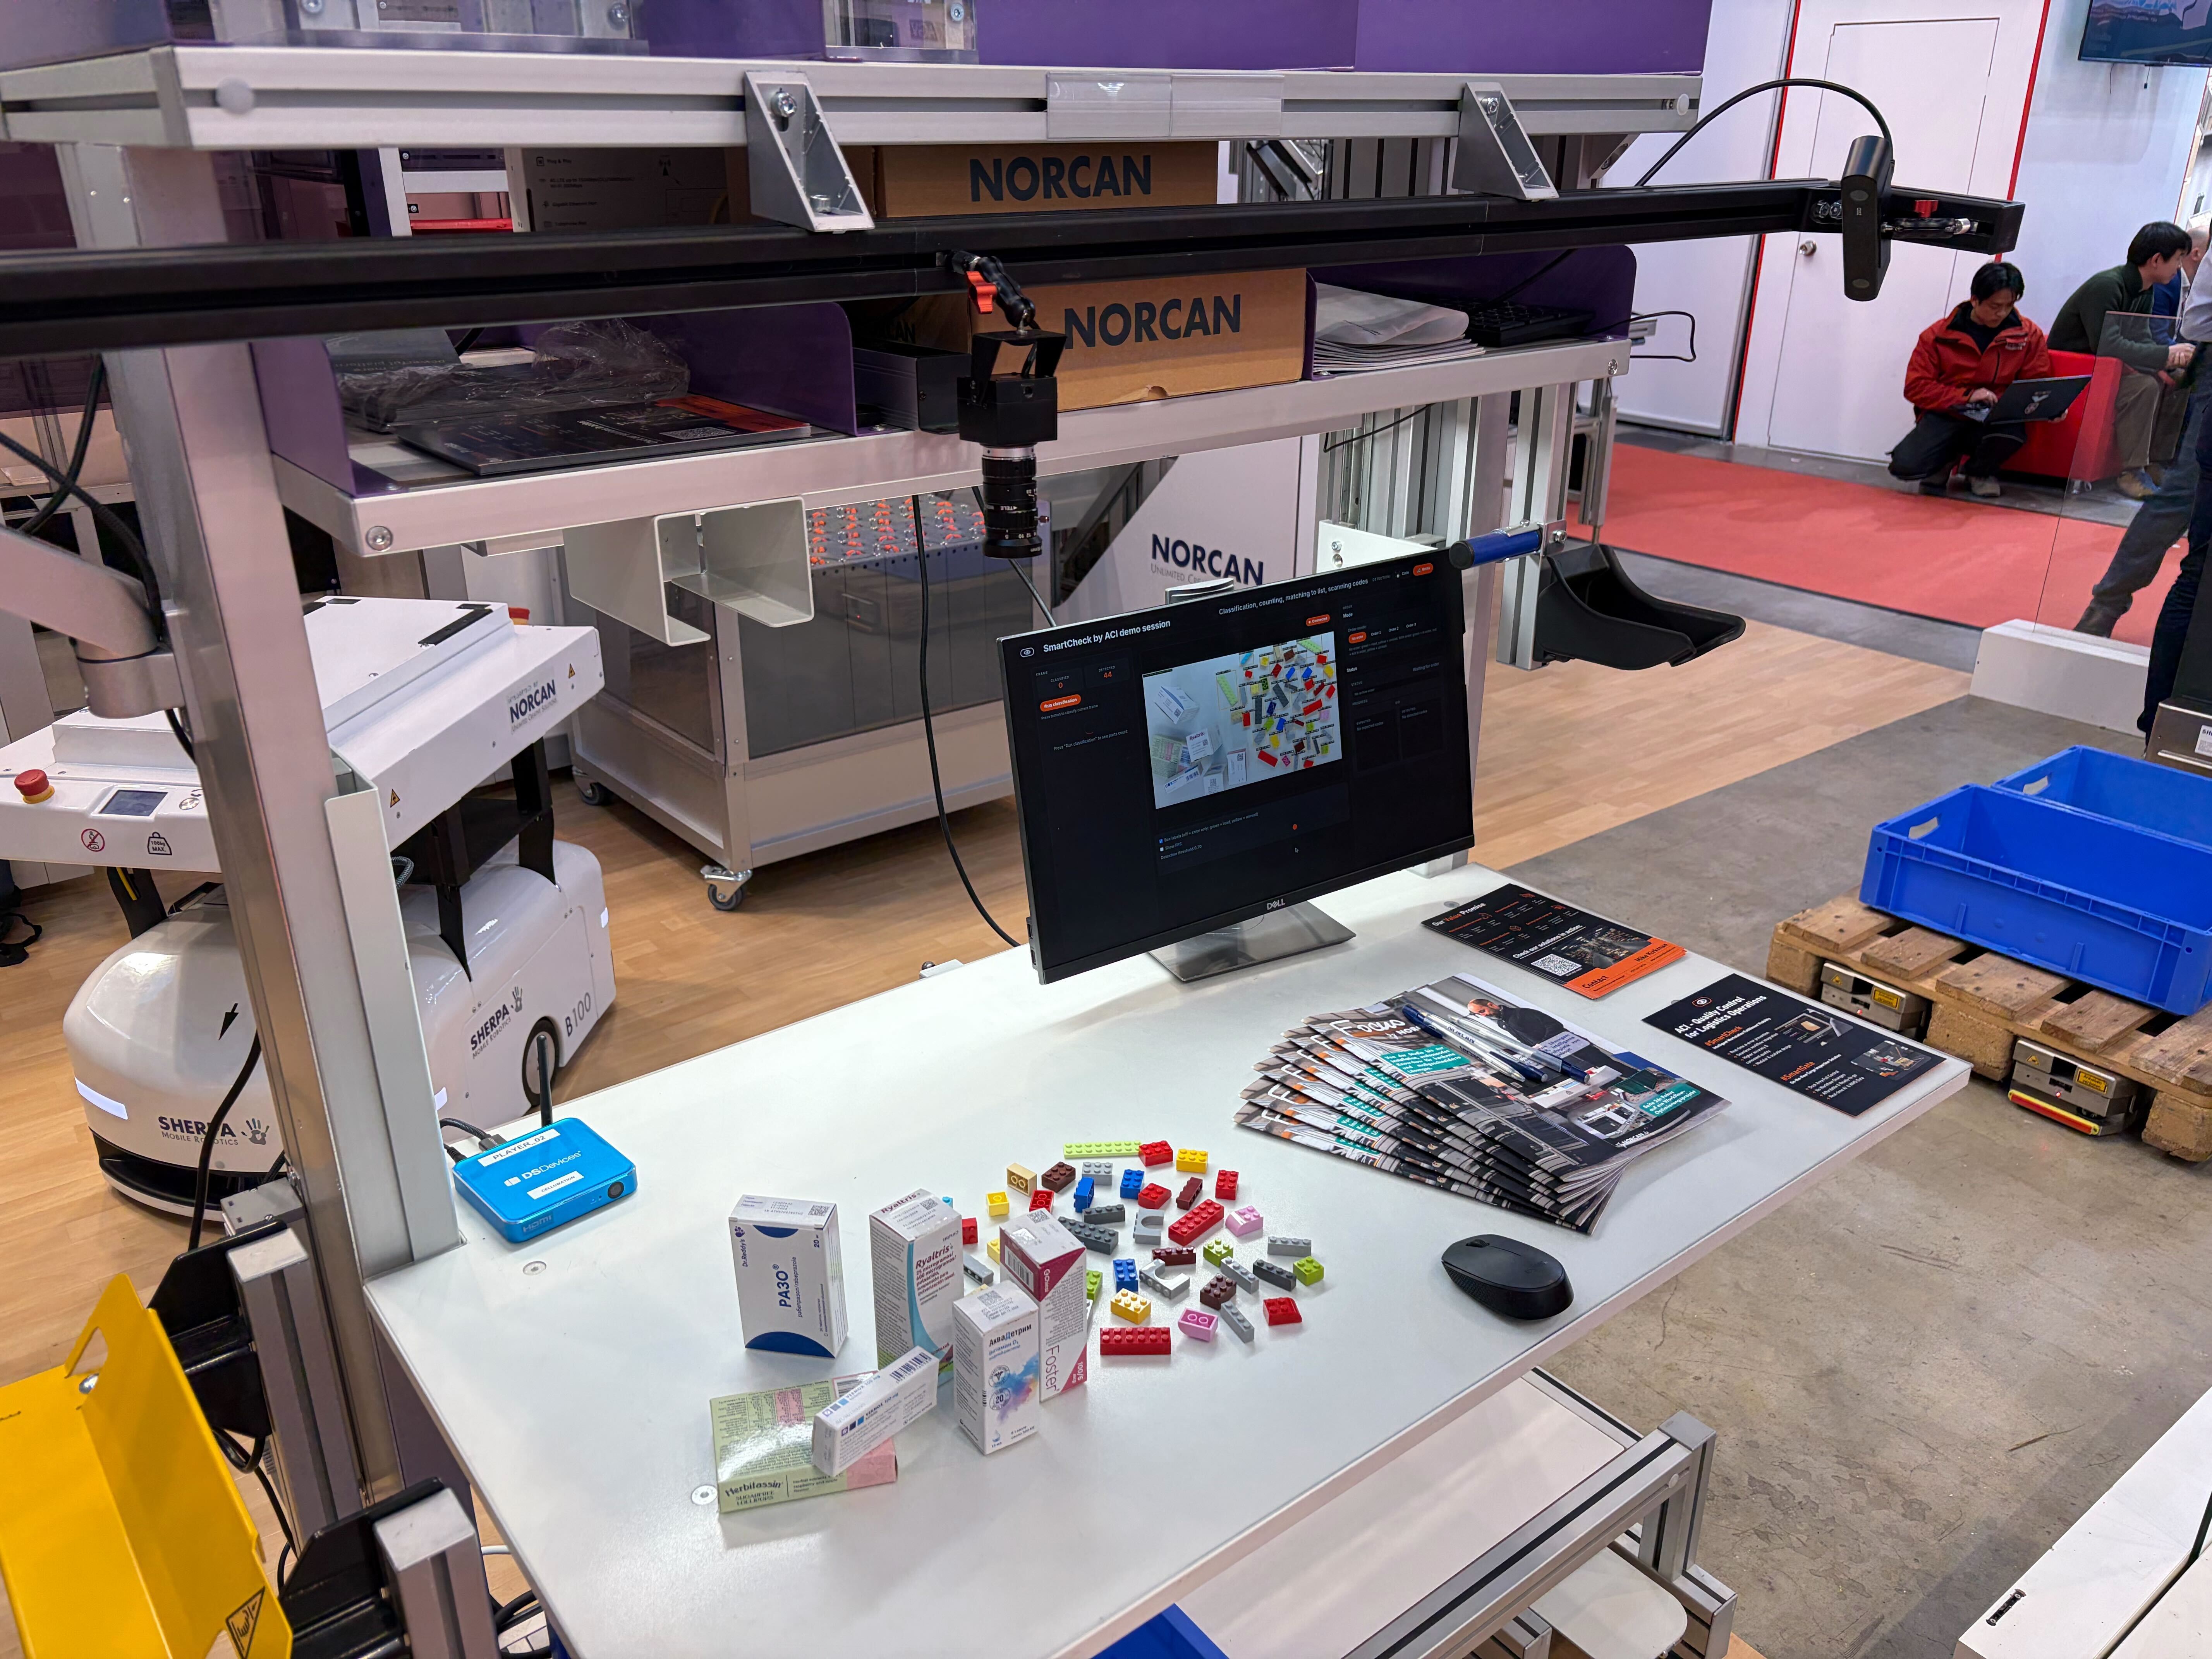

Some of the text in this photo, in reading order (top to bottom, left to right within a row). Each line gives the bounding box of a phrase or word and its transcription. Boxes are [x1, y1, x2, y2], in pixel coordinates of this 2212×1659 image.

[970, 154, 1151, 203] NORCAN
[1064, 294, 1240, 349] NORCAN
[1152, 534, 1264, 586] NORCAN
[1219, 601, 1258, 615] Classification,
[1259, 596, 1285, 608] counting,
[1285, 590, 1310, 602] matching
[1317, 586, 1327, 595] list,
[1328, 582, 1352, 593] scanning
[1352, 579, 1369, 587] codes
[1043, 621, 1170, 652] SmartCheck by ACI demo session
[510, 680, 555, 723] NORCAN
[1053, 697, 1077, 706] classification
[1267, 898, 1285, 910] DELL
[1459, 903, 1486, 914] Promise
[1513, 950, 1530, 958] Check
[1538, 935, 1561, 947] solutions
[1582, 975, 1608, 988] Contact
[1331, 1013, 1404, 1036] Focus
[1674, 996, 1745, 1033] ACI Quality Control
[1696, 1015, 1731, 1032] Logistics
[1727, 996, 1766, 1015] Operations
[471, 1004, 509, 1051] SHERPA
[472, 1016, 511, 1060] MOBILE ROBOTICS
[1705, 1026, 1742, 1046] #SmartCheck
[1781, 1062, 1814, 1080] #SmartGate
[1654, 1090, 1696, 1114] Optimierungsprojekt
[1662, 1090, 1685, 1103] Workflow-
[158, 1116, 236, 1137] SHERA
[161, 1132, 239, 1145] MOBILE ROOTICS
[493, 1136, 546, 1160] PLAYER_02
[541, 1175, 575, 1193] CELLUMATION
[881, 1193, 916, 1213] Ryaltris
[915, 1245, 949, 1269] Ryaltris
[996, 1395, 1004, 1404] 20
